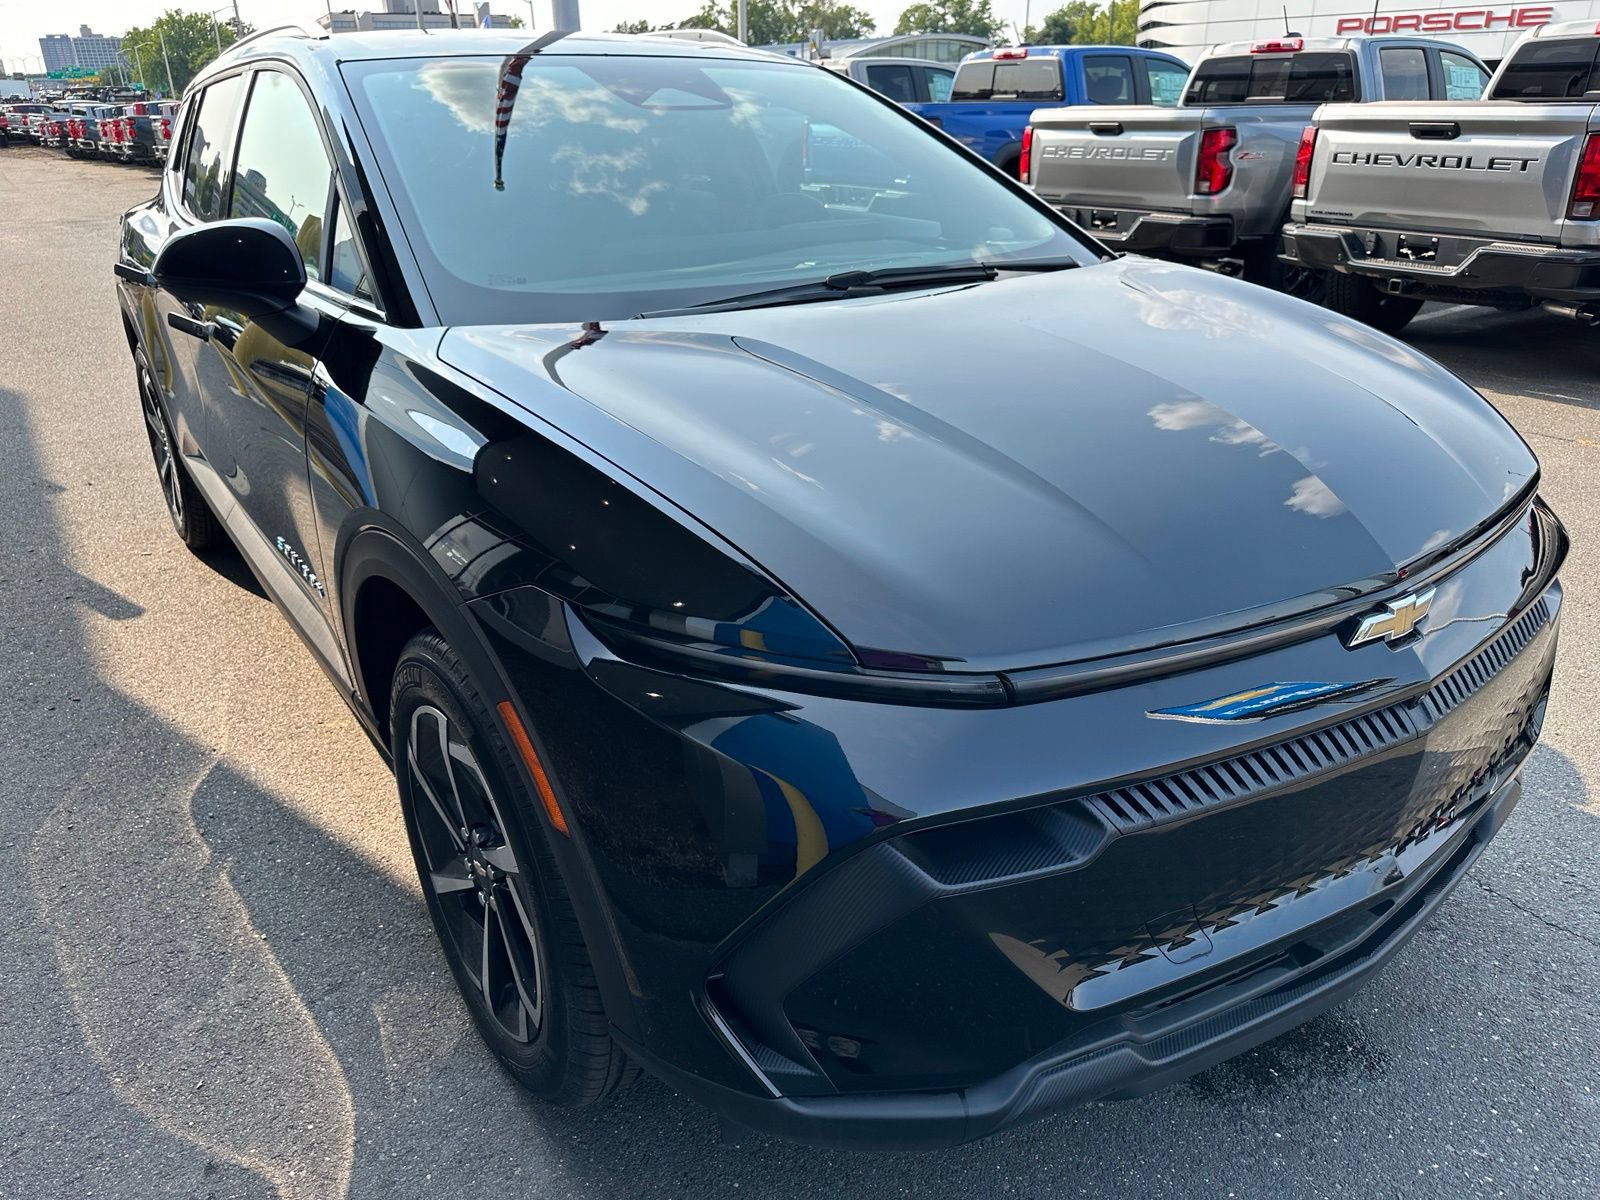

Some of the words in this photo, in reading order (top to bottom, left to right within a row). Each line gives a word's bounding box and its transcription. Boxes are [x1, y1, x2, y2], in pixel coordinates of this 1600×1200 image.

[1336, 7, 1554, 35] PORSCHE
[1042, 146, 1175, 161] CHEVROLET
[1332, 152, 1539, 172] CHEVROLET
